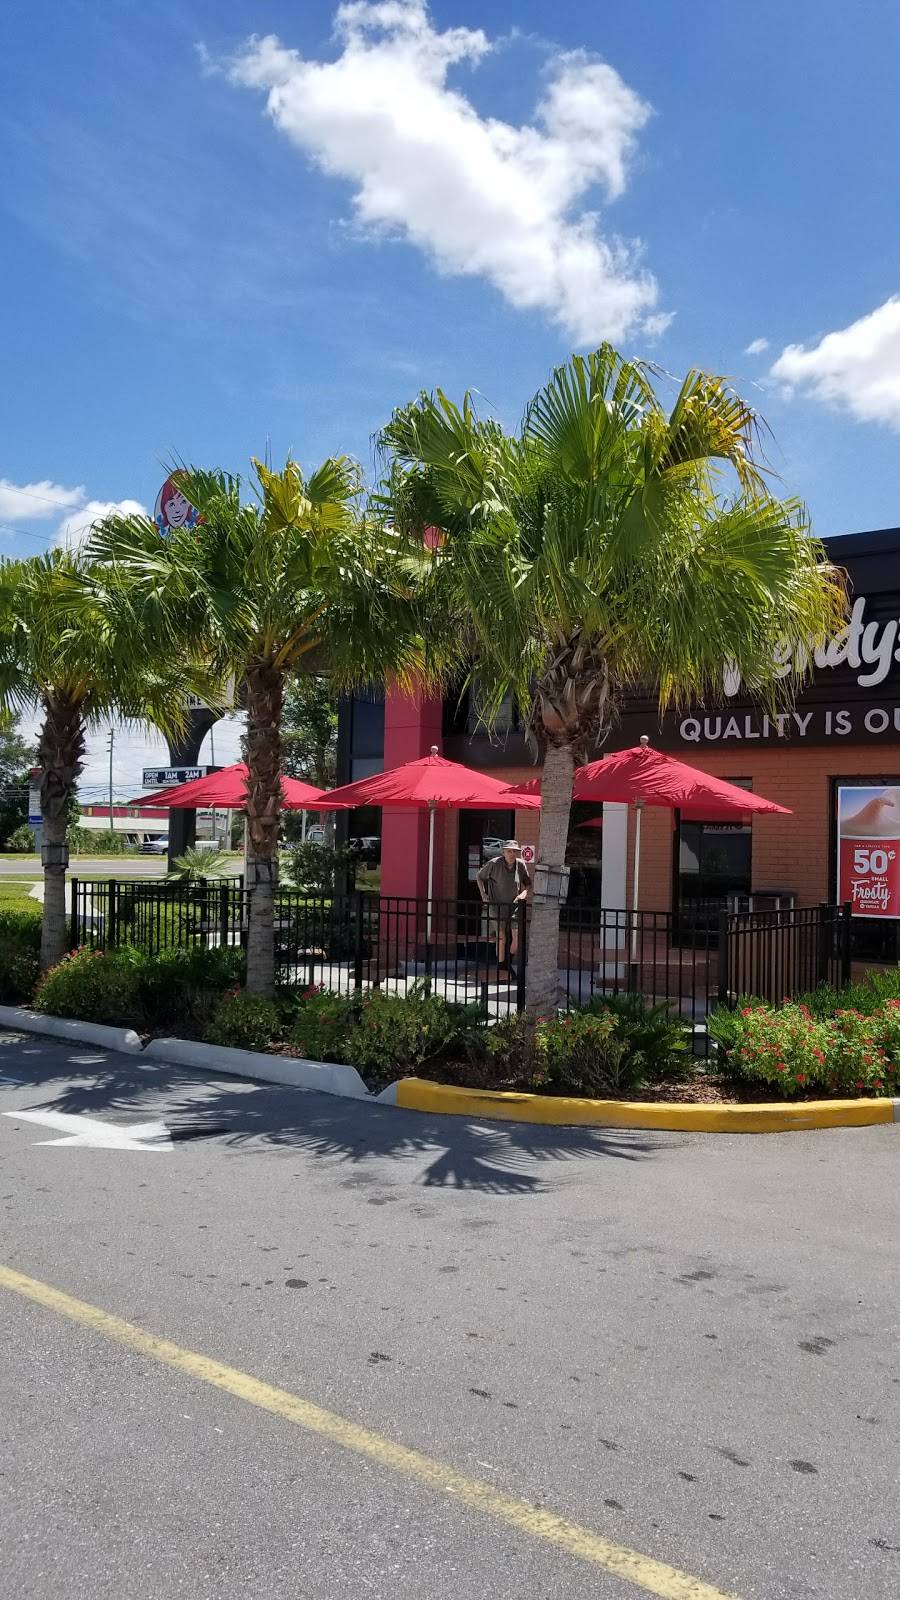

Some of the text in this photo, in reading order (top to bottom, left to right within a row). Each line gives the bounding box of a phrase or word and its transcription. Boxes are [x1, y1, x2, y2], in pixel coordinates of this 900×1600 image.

[679, 712, 813, 742] QUALITY
[825, 710, 852, 735] IS
[164, 771, 178, 780] 1AM
[184, 770, 200, 779] 2AM
[851, 880, 891, 910] Frosty
